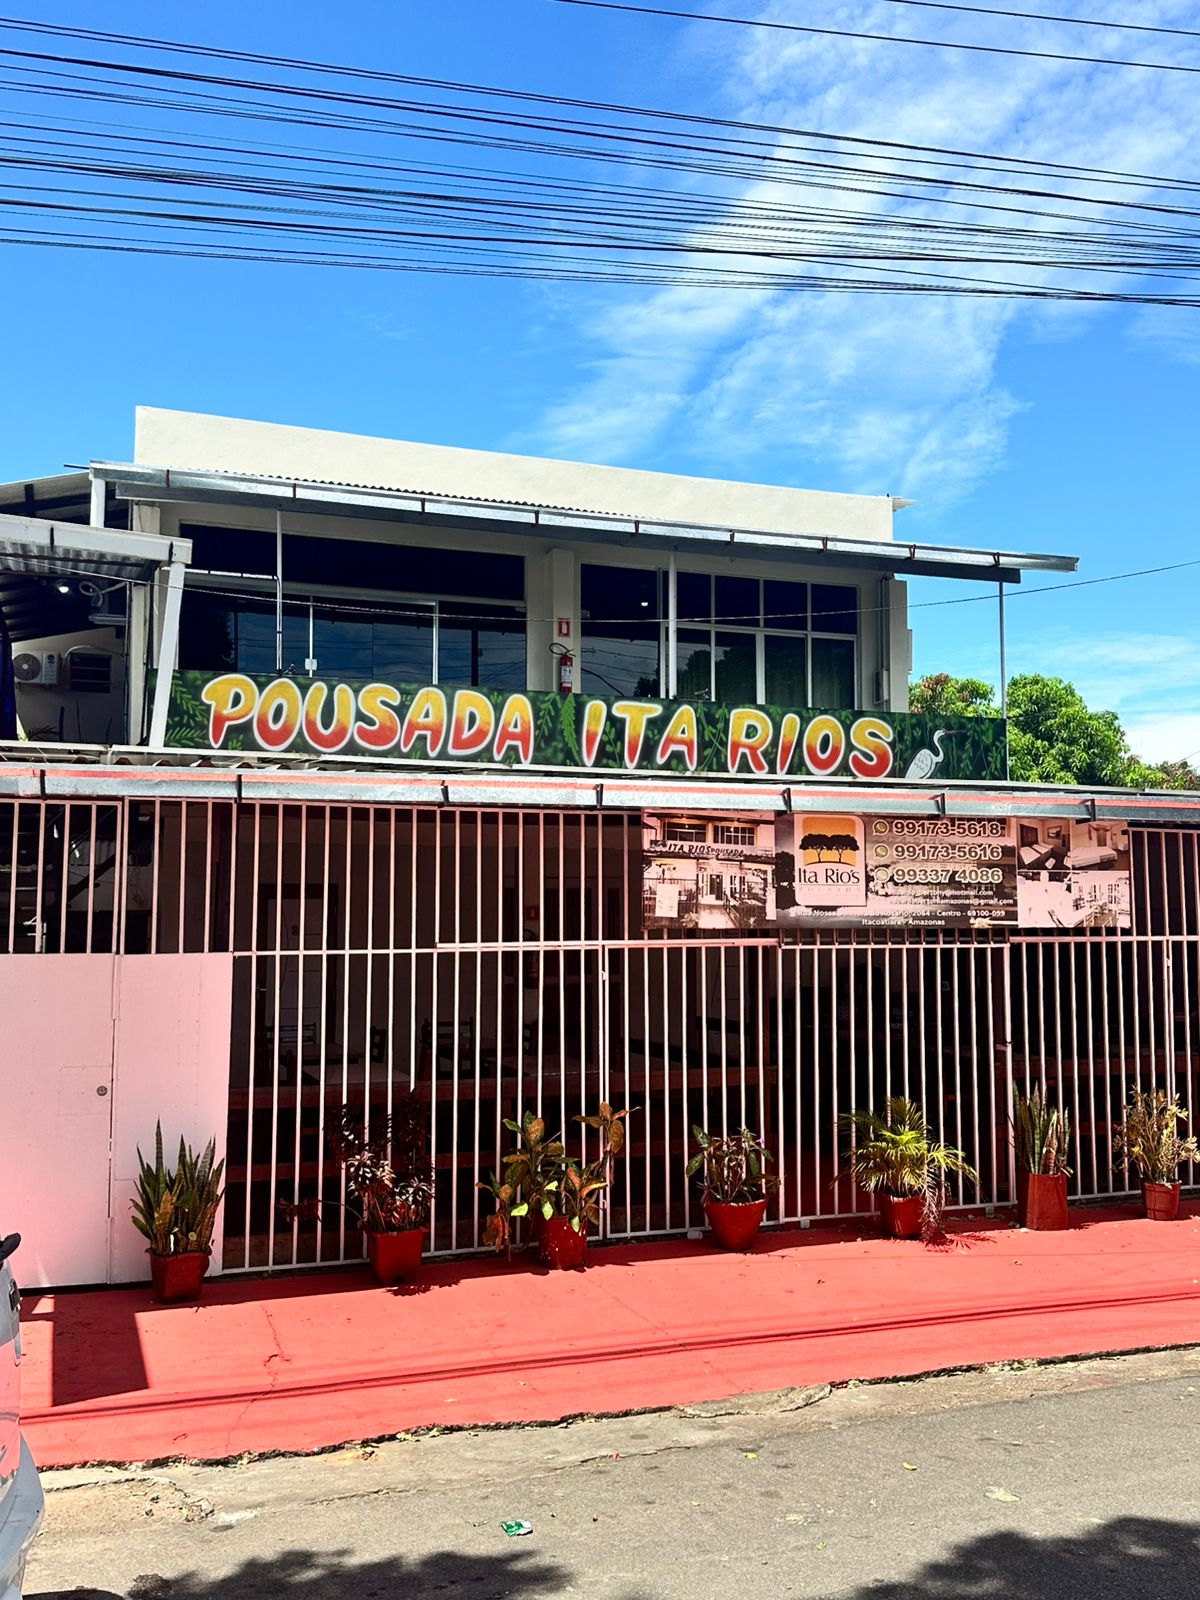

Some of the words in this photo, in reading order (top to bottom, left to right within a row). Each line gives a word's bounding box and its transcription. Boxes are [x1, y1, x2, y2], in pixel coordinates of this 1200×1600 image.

[201, 674, 535, 764] POUSADA
[581, 700, 698, 771] ITA
[727, 708, 895, 778] RIOS
[893, 820, 1002, 837] 99173-5618
[894, 844, 1003, 860] 99173-5616
[798, 868, 818, 884] Ita
[825, 868, 860, 884] Rio's
[955, 869, 1003, 884] 4086
